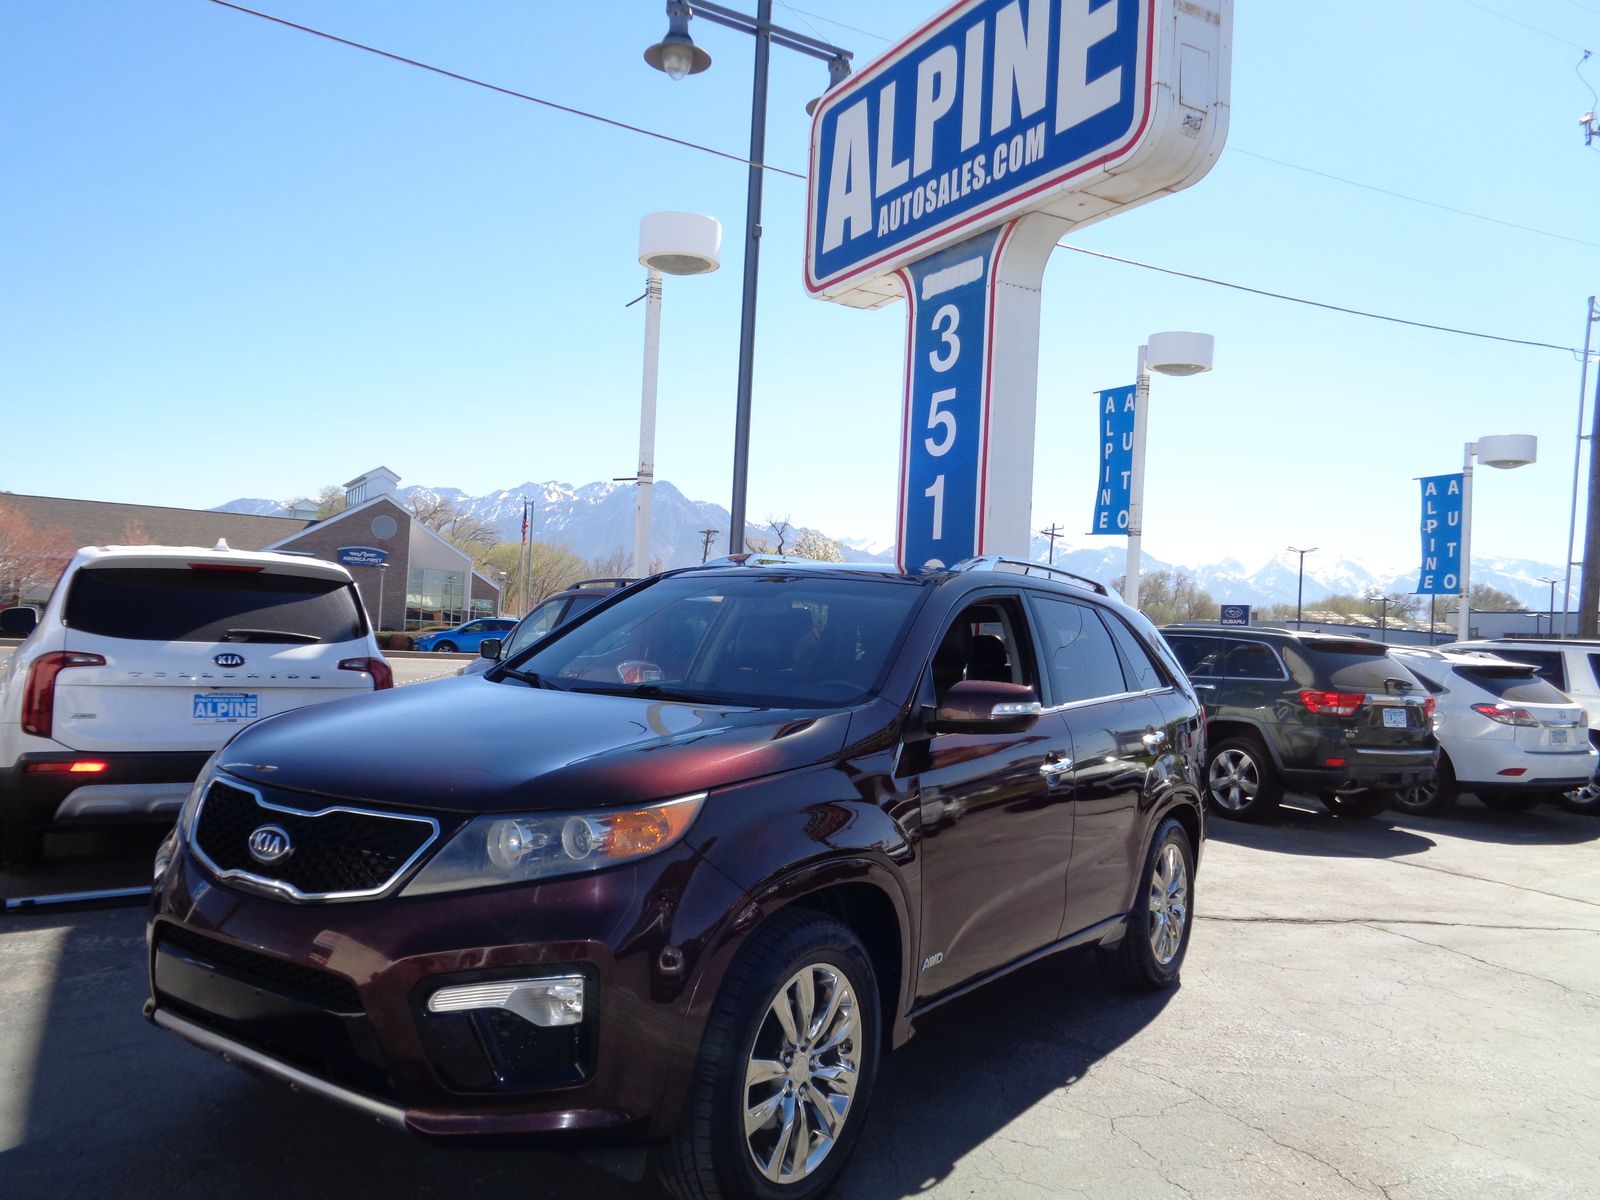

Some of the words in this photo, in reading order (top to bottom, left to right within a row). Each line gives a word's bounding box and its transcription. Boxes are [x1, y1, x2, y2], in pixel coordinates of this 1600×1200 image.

[822, 0, 1122, 255] ALPINE
[877, 121, 1045, 238] AUTOSALES.COM
[924, 304, 961, 569] 351
[1100, 396, 1115, 529] ALPINE
[1117, 393, 1135, 529] AUTO
[1423, 482, 1438, 589] ALPINE
[1443, 479, 1459, 589] AUTO
[194, 702, 257, 717] ALPINE
[217, 655, 241, 665] KIA
[253, 832, 280, 854] KIA
